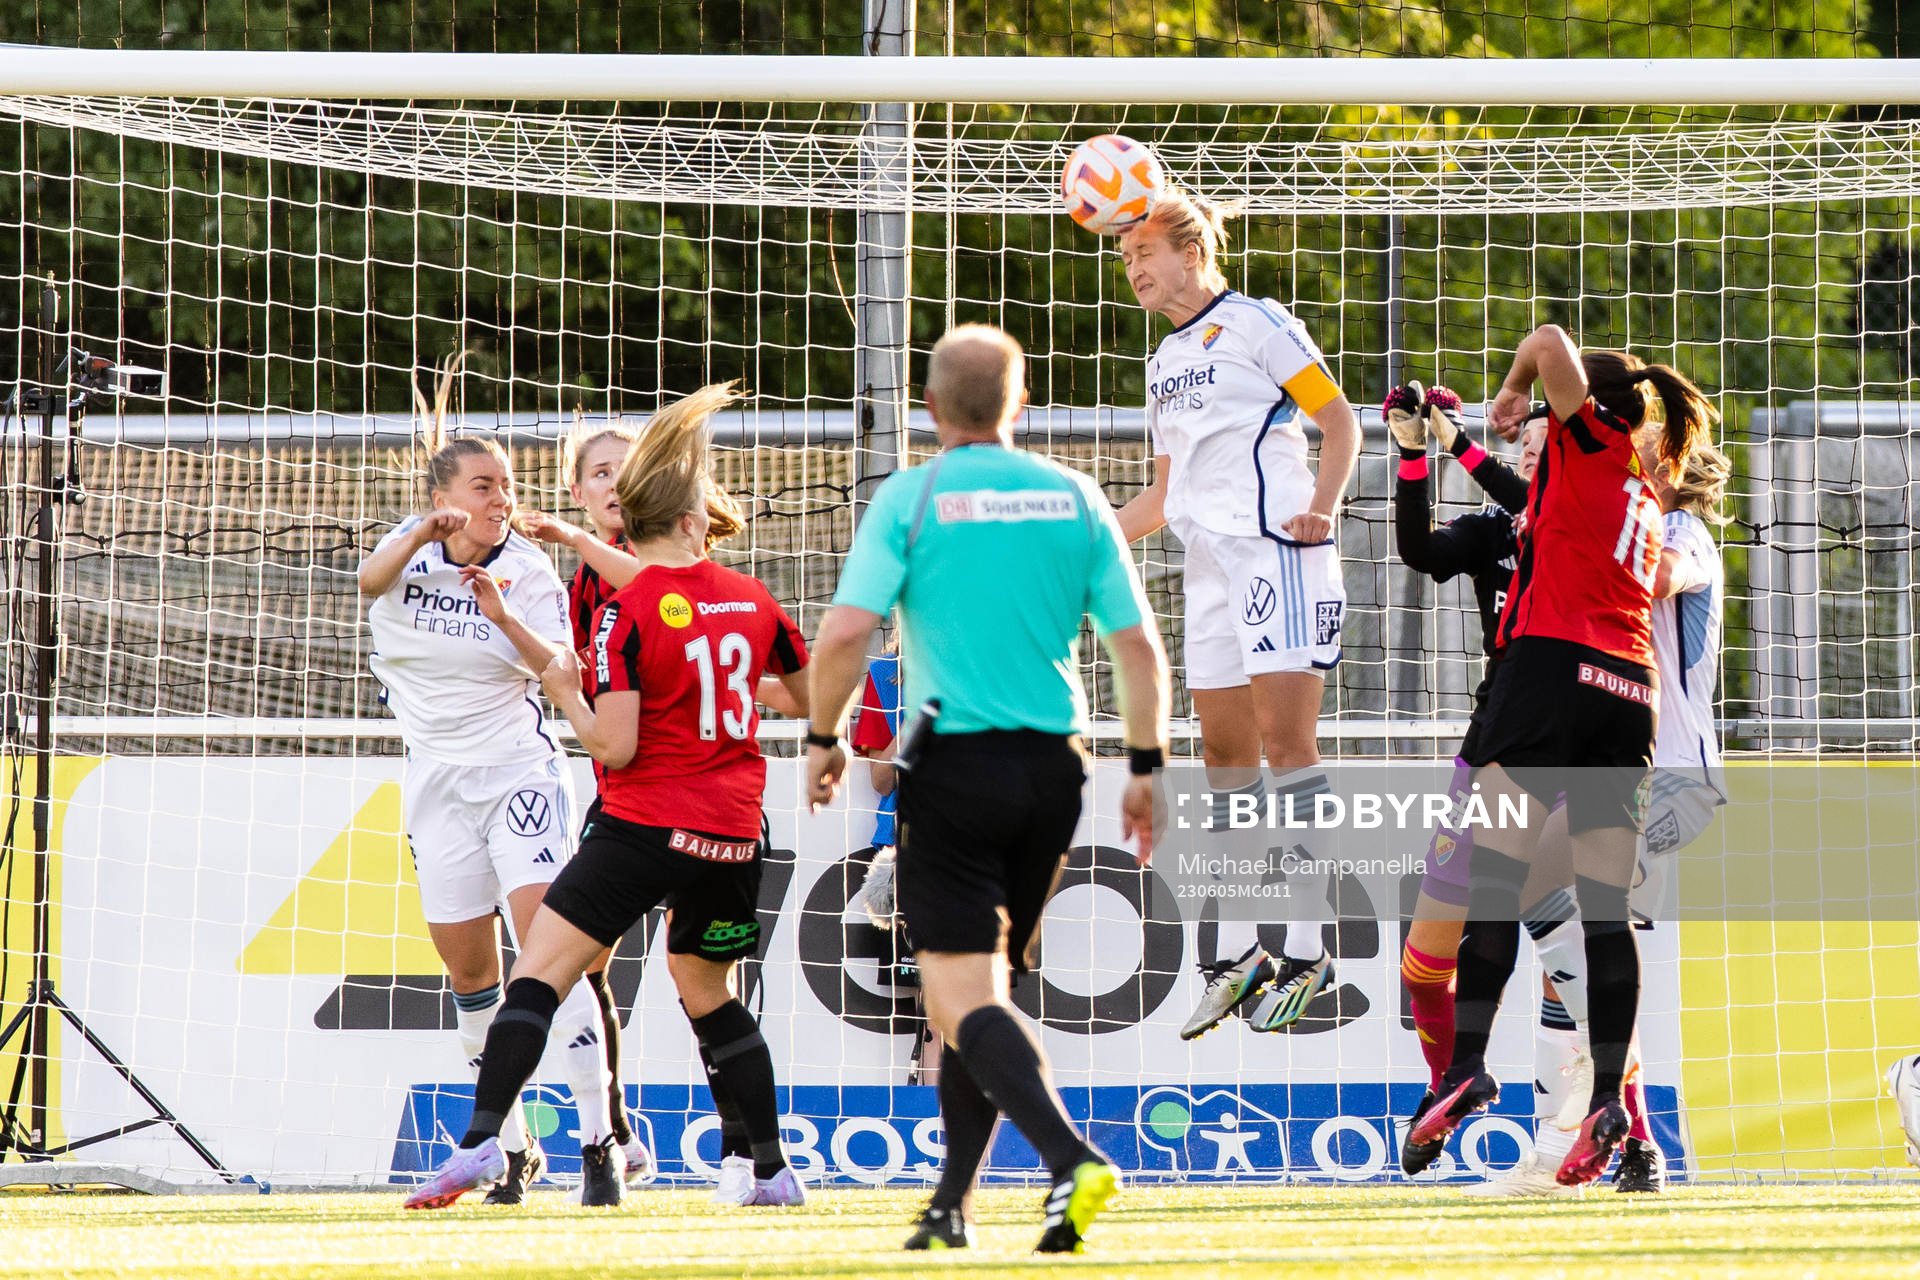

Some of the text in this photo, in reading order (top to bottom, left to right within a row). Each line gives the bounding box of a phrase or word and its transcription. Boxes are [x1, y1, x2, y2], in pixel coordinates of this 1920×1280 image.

[403, 583, 482, 616] Priorit
[663, 601, 757, 617] Yale Doorman
[414, 608, 490, 641] Finans
[594, 607, 619, 683] stadium
[684, 631, 753, 741] 13
[1581, 666, 1652, 703] BAUHAU
[671, 832, 755, 861] BAUHAUS
[703, 922, 760, 941] coop
